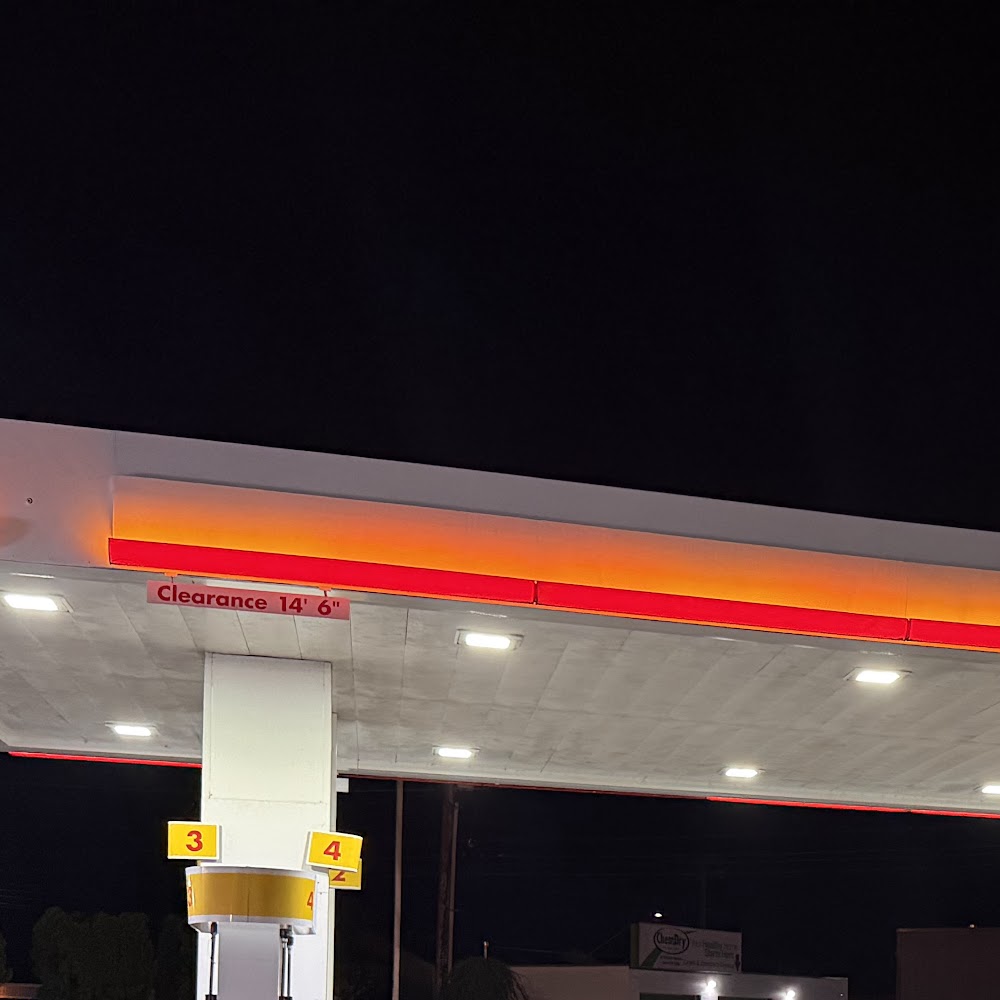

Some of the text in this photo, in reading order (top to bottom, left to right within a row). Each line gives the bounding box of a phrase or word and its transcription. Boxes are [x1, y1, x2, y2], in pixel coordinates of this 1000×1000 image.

[156, 584, 340, 616] Clearance 14' 6"
[185, 830, 204, 852] 3
[323, 840, 342, 861] 4
[307, 891, 314, 911] 4
